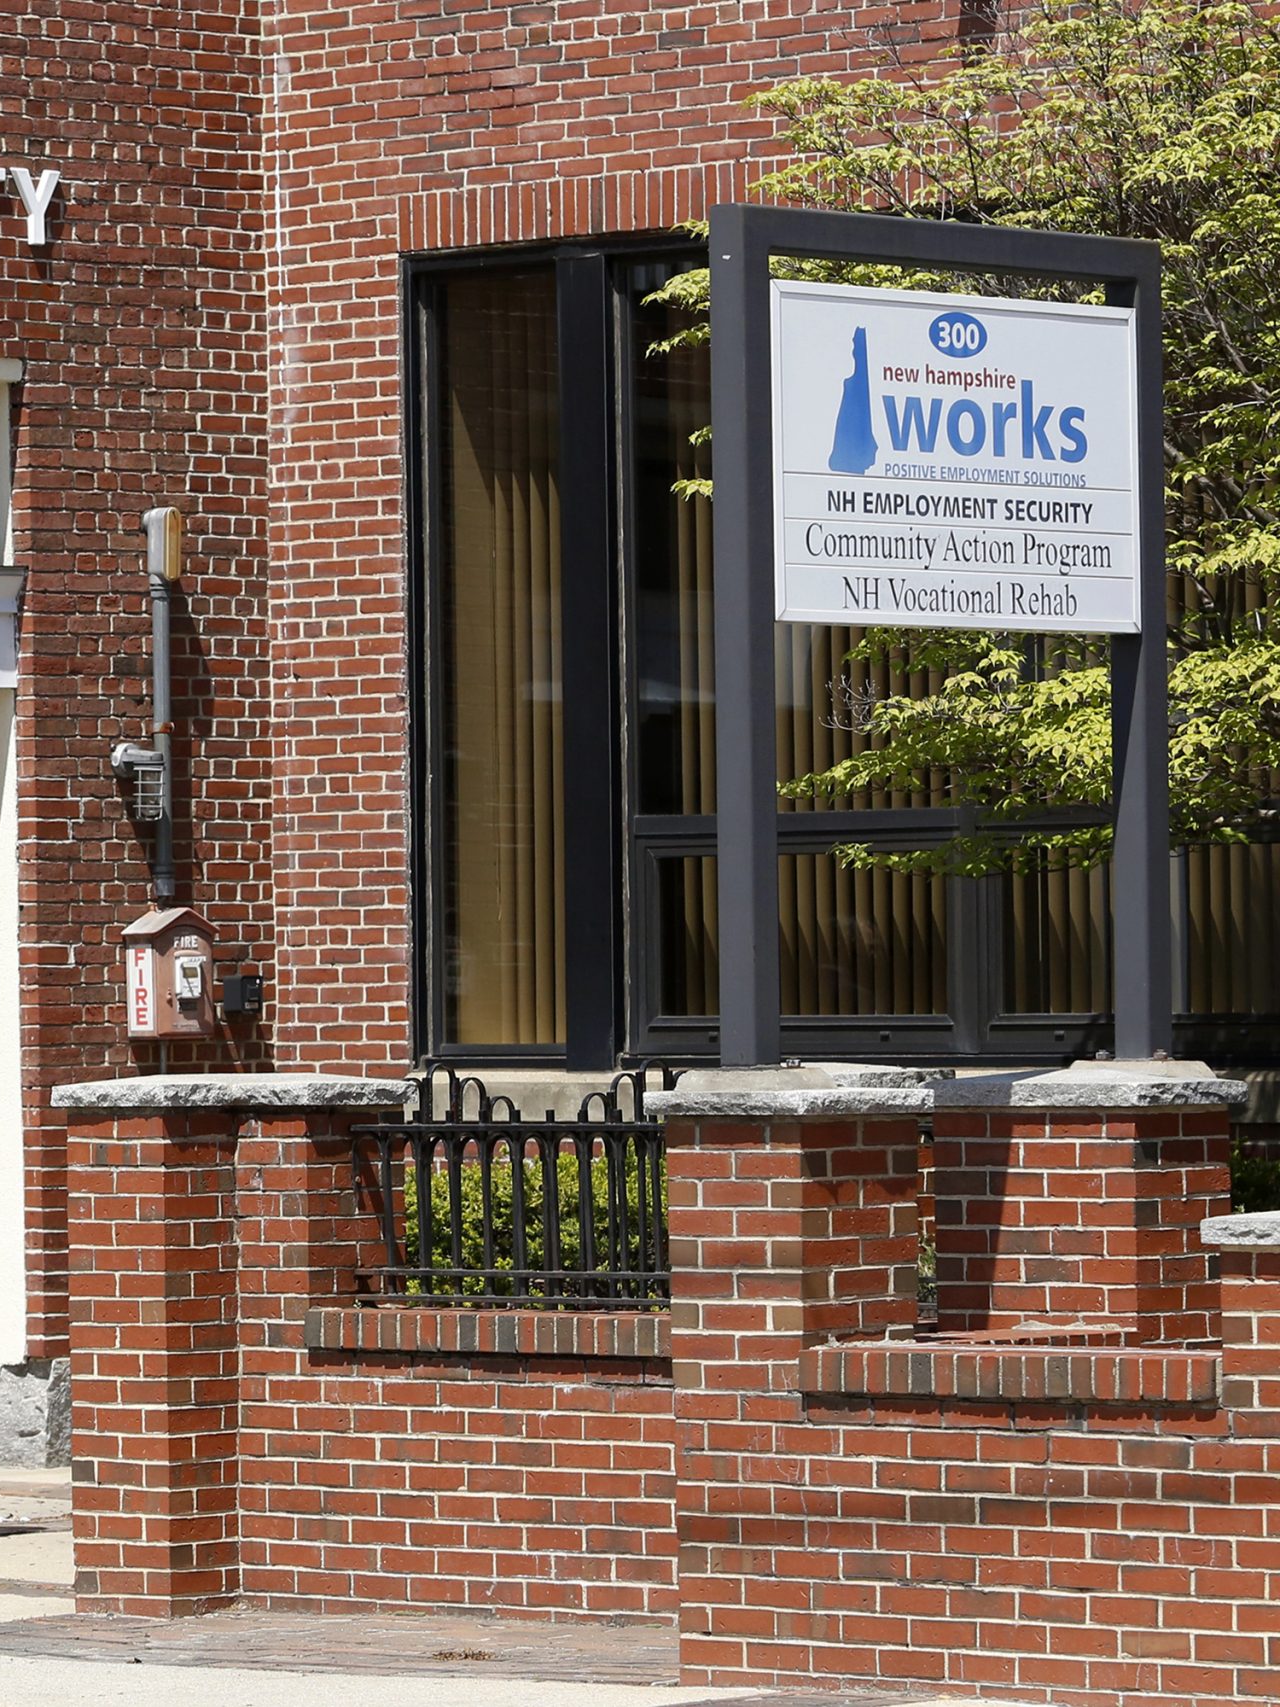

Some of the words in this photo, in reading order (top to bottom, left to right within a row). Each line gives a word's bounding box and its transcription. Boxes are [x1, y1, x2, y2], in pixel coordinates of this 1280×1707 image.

[937, 321, 980, 350] 300
[882, 364, 919, 384] new
[925, 363, 1016, 391] hampshire
[881, 379, 1088, 464] works
[884, 462, 937, 480] POSITIVE
[940, 466, 1021, 485] EMPLOYMENT
[1023, 470, 1087, 488] SOLUTIONS
[827, 489, 856, 513] NH
[863, 491, 998, 520] EMPLOYMENT
[1004, 498, 1094, 525] SECURITY
[805, 522, 936, 570] Community
[943, 530, 1015, 564] Action
[1021, 533, 1113, 576] Program
[841, 575, 880, 610] NH
[887, 577, 1003, 615] Vocational
[1010, 581, 1078, 617] Rehab
[174, 935, 198, 948] FIRE
[134, 948, 148, 1026] FIRE
